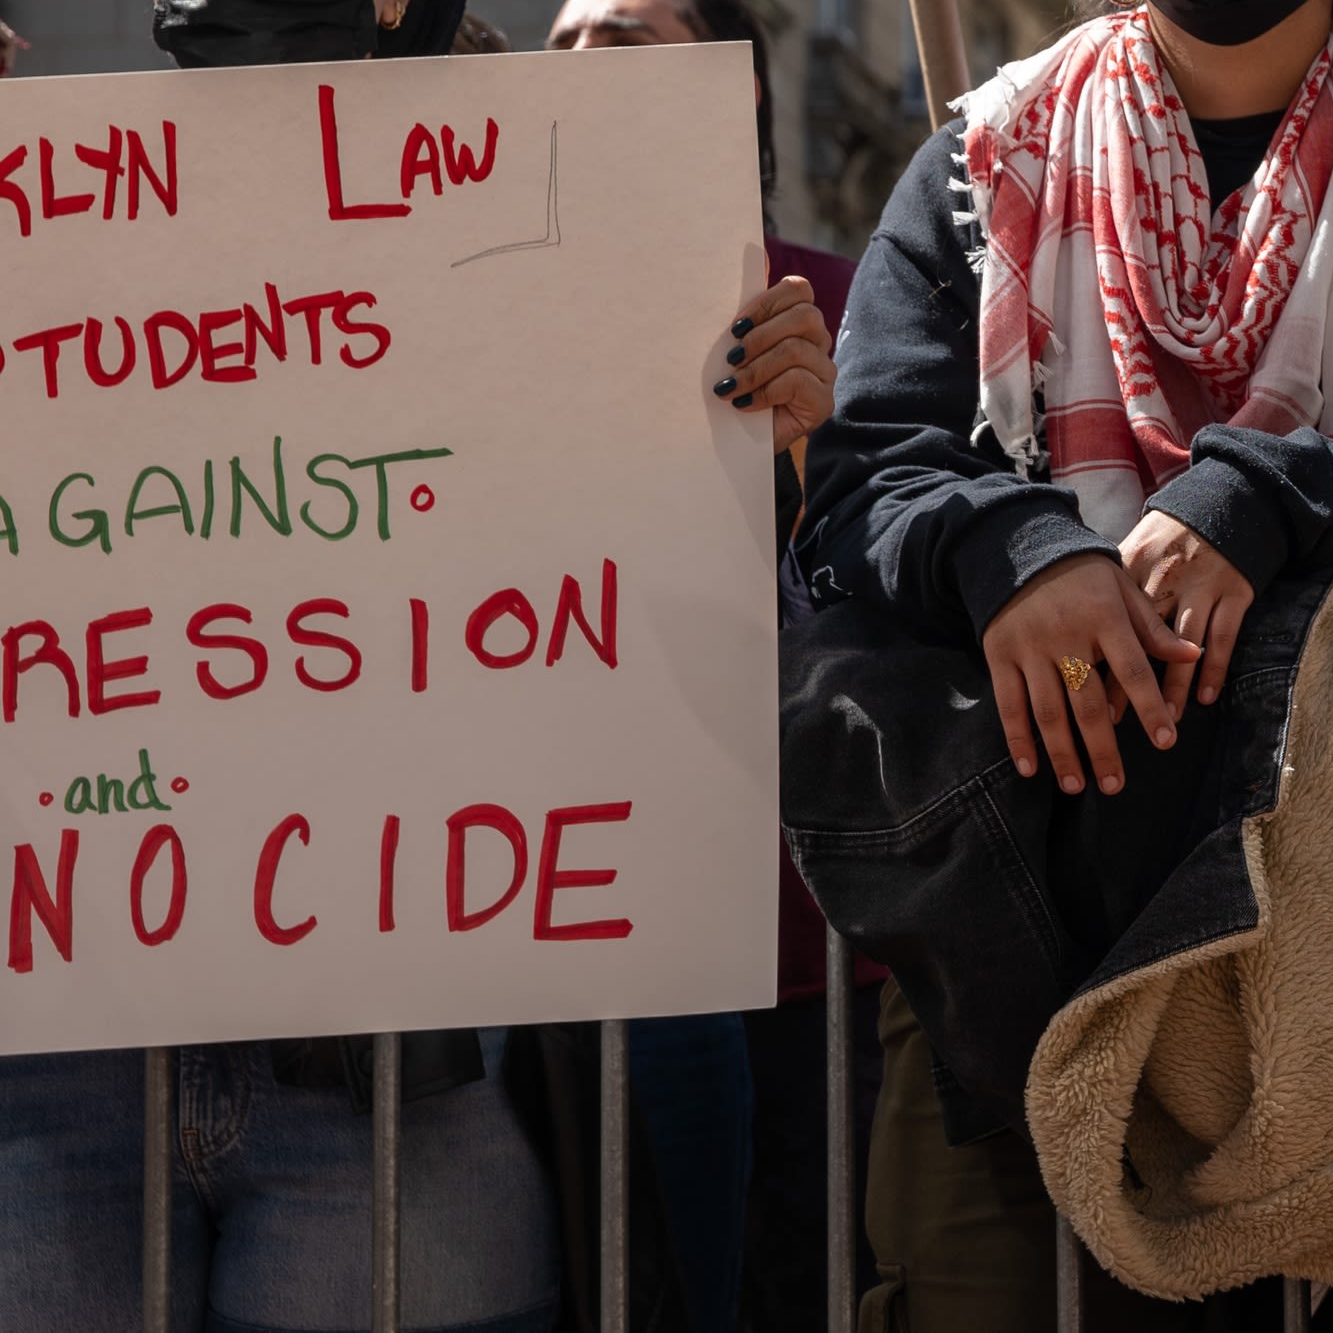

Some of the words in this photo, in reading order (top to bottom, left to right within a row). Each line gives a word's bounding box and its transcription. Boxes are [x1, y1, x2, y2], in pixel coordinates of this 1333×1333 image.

[0, 281, 392, 399] TUDENTS
[0, 558, 619, 724] RESSION
[7, 801, 634, 974] NOCIDE
